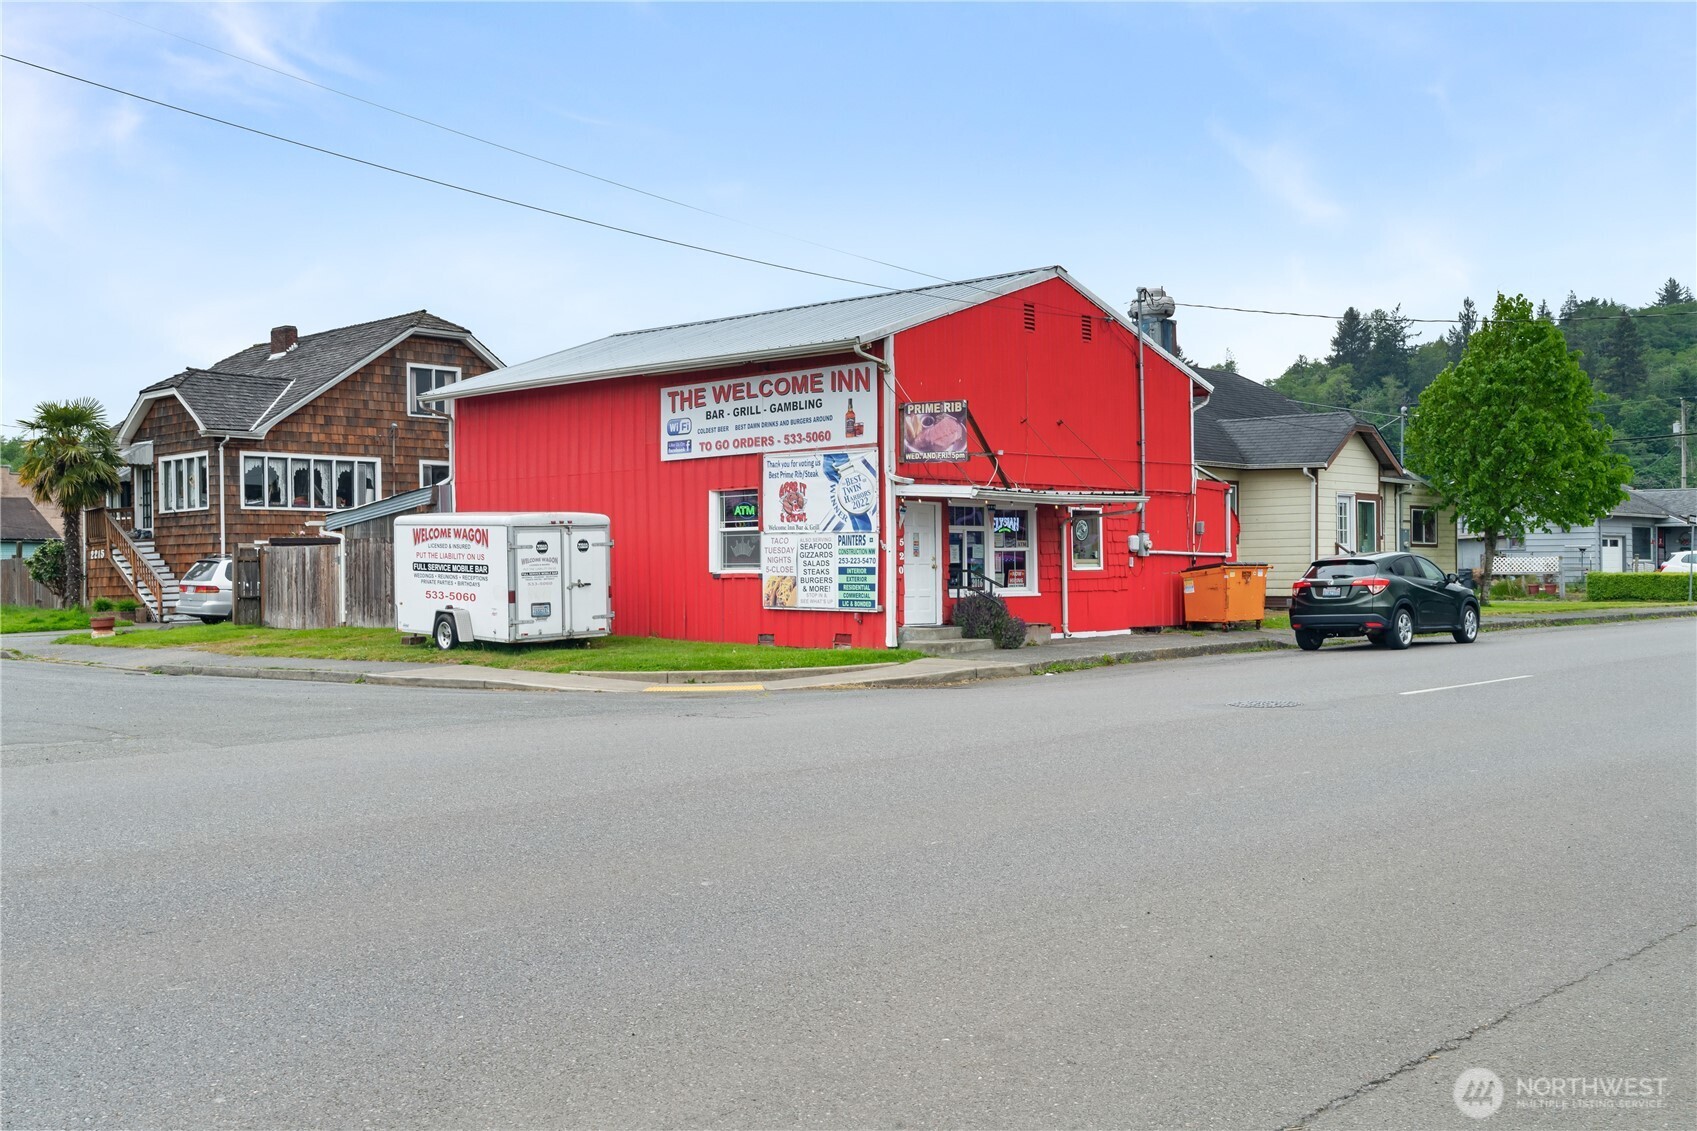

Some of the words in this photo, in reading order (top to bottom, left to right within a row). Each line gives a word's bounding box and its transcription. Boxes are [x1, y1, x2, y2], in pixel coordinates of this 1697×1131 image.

[667, 388, 706, 413] THE
[712, 372, 824, 404] WELCOME
[830, 366, 870, 392] INN
[706, 409, 725, 420] BAR
[733, 404, 761, 417] GRILL
[770, 398, 823, 413] GAMBLING
[907, 403, 940, 414] PRIME
[944, 402, 962, 413] RIB
[697, 426, 716, 434] COLDEST
[790, 417, 812, 425] BURGERS
[813, 415, 833, 423] AROUND
[699, 442, 712, 452] TO
[715, 440, 729, 451] GO
[733, 436, 774, 449] ORDERS
[784, 430, 831, 445] 533-5060
[799, 460, 814, 468] voting
[795, 470, 819, 478] Rib/Steak
[845, 474, 862, 486] BEST
[842, 483, 862, 495] TWIN
[830, 484, 848, 522] WINNER
[853, 497, 869, 509] 2022
[734, 505, 755, 516] ATM
[413, 528, 452, 546] WELCOME
[453, 528, 489, 548] WAGON
[838, 535, 866, 546] PAINTERS
[425, 590, 476, 602] 533-5060
